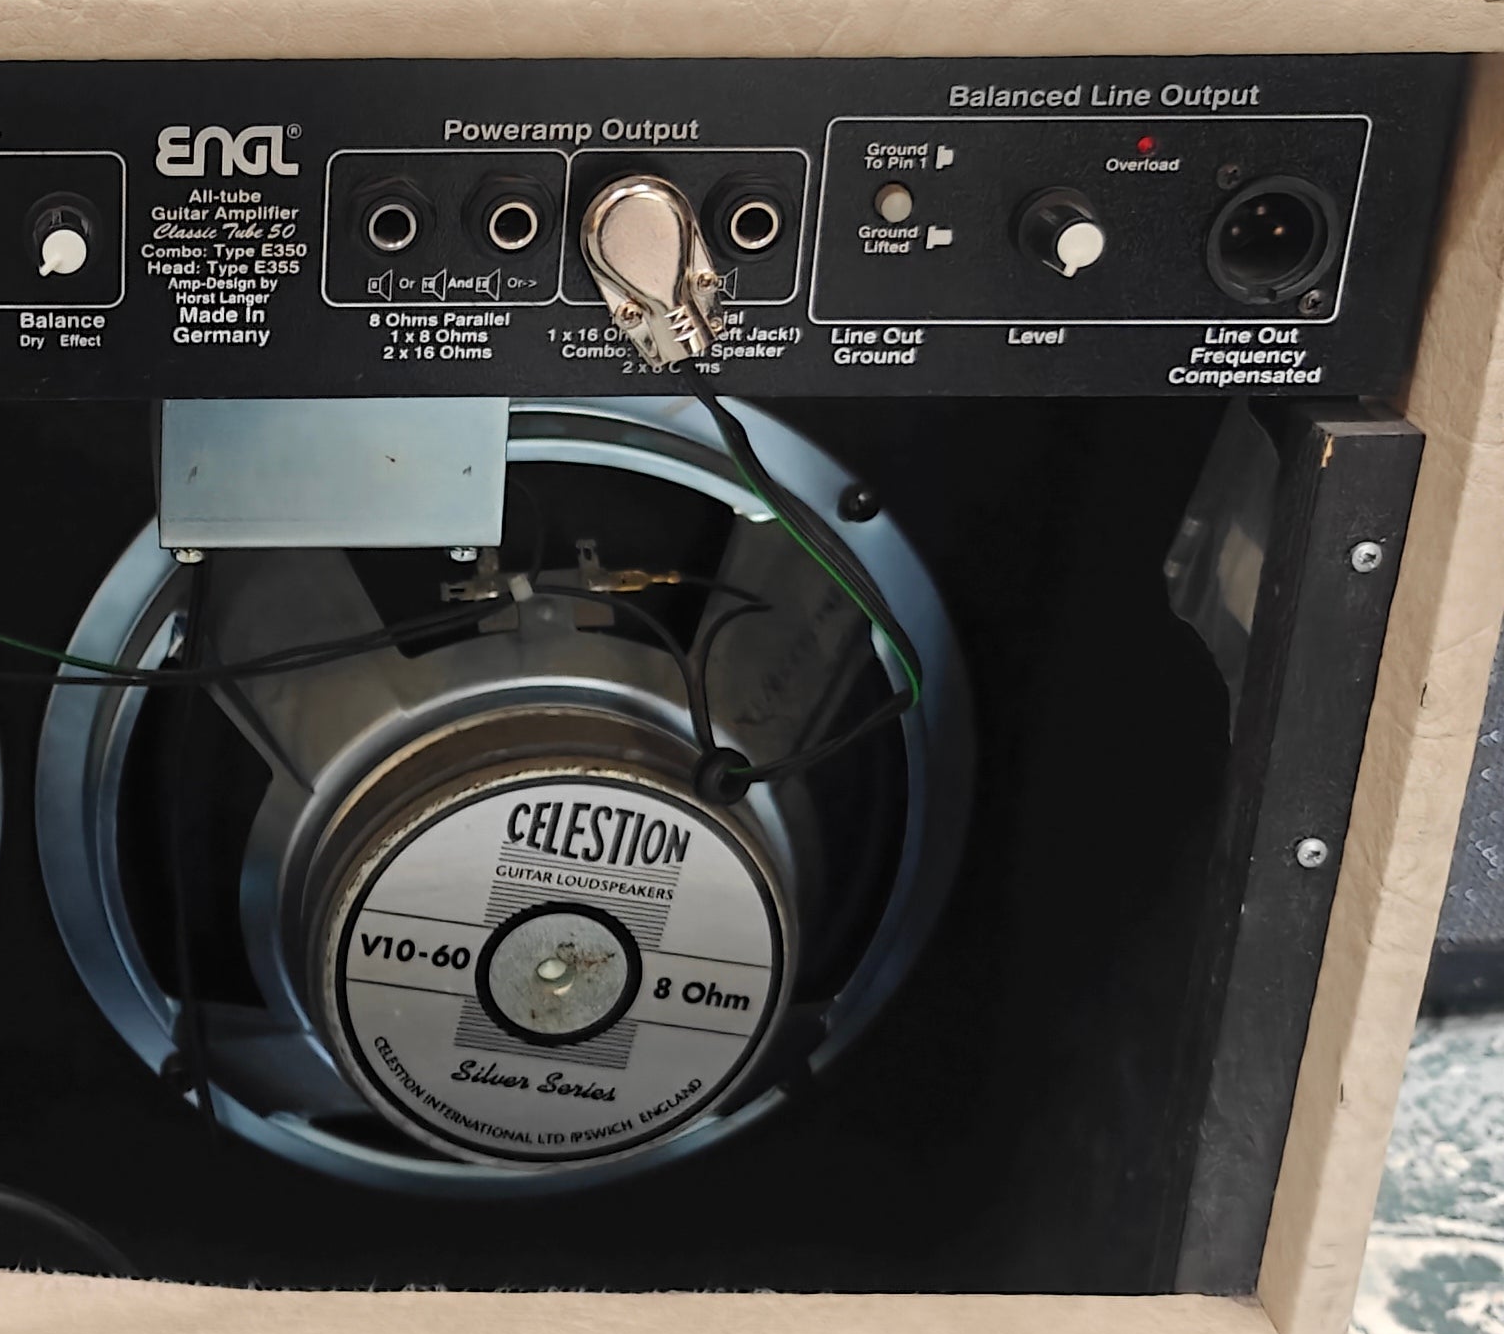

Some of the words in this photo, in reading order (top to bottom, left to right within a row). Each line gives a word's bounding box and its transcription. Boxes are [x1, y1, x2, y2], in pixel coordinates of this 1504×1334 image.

[949, 84, 1082, 108] Balanced
[1091, 85, 1151, 107] Line
[1160, 84, 1261, 111] Output
[444, 118, 592, 145] Poweramp
[601, 118, 699, 145] Output
[867, 143, 929, 157] Ground
[864, 156, 885, 169] To
[888, 156, 914, 169] Pin
[919, 156, 927, 169] 1
[1106, 159, 1180, 172] Overload
[188, 189, 262, 204] All-tube
[151, 207, 210, 221] Guitar
[214, 206, 300, 223] Amplifier
[153, 223, 218, 240] Classic
[222, 223, 264, 240] Tube
[267, 223, 296, 239] 50
[858, 227, 918, 241] Ground
[141, 244, 208, 259] Combo:
[213, 244, 256, 260] Type
[261, 243, 308, 258] E350
[863, 240, 910, 254] Lifted
[147, 260, 200, 275] Head:
[206, 260, 249, 277] Type
[254, 260, 300, 275] E355
[168, 277, 256, 292] Amp-Design
[260, 277, 278, 292] by
[399, 278, 416, 289] Or
[447, 278, 473, 288] And
[176, 292, 216, 304] Horst
[219, 292, 270, 307] Langer
[20, 312, 106, 329] Balance
[179, 306, 238, 324] Made
[369, 313, 380, 327] 8
[385, 313, 438, 327] Ohms
[444, 312, 510, 326] Parallel
[20, 334, 45, 350] Dry
[60, 334, 102, 348] Effect
[173, 326, 271, 347] Germany
[419, 329, 430, 343] 8
[436, 329, 488, 343] Ohms
[577, 328, 597, 341] 16
[747, 327, 801, 343] Jack!)
[831, 329, 882, 345] Line
[884, 328, 925, 345] Out
[1008, 328, 1066, 345] Level
[1205, 328, 1255, 344] Line
[1259, 328, 1300, 344] Out
[383, 346, 394, 359] 2
[415, 346, 435, 359] 16
[440, 345, 493, 359] Ohms
[562, 345, 631, 358] Combo:
[711, 344, 785, 360] Speaker
[833, 348, 917, 365] Ground
[1191, 348, 1306, 368] Frequency
[1168, 367, 1321, 387] Compensated
[507, 801, 691, 867] CELESTION
[495, 865, 552, 885] GUITAR
[556, 871, 674, 901] LOUDSPEAKERS
[360, 933, 471, 969] V10-60
[653, 976, 671, 999] 8
[682, 981, 751, 1011] Ohm
[451, 1059, 531, 1090] Silver
[536, 1072, 617, 1102] Series
[374, 1035, 425, 1098] CELESTION
[423, 1091, 533, 1144] INTERNATIONAL
[537, 1131, 565, 1145] LTD
[569, 1118, 633, 1144] IPSWICH
[639, 1077, 702, 1124] ENGLAND
